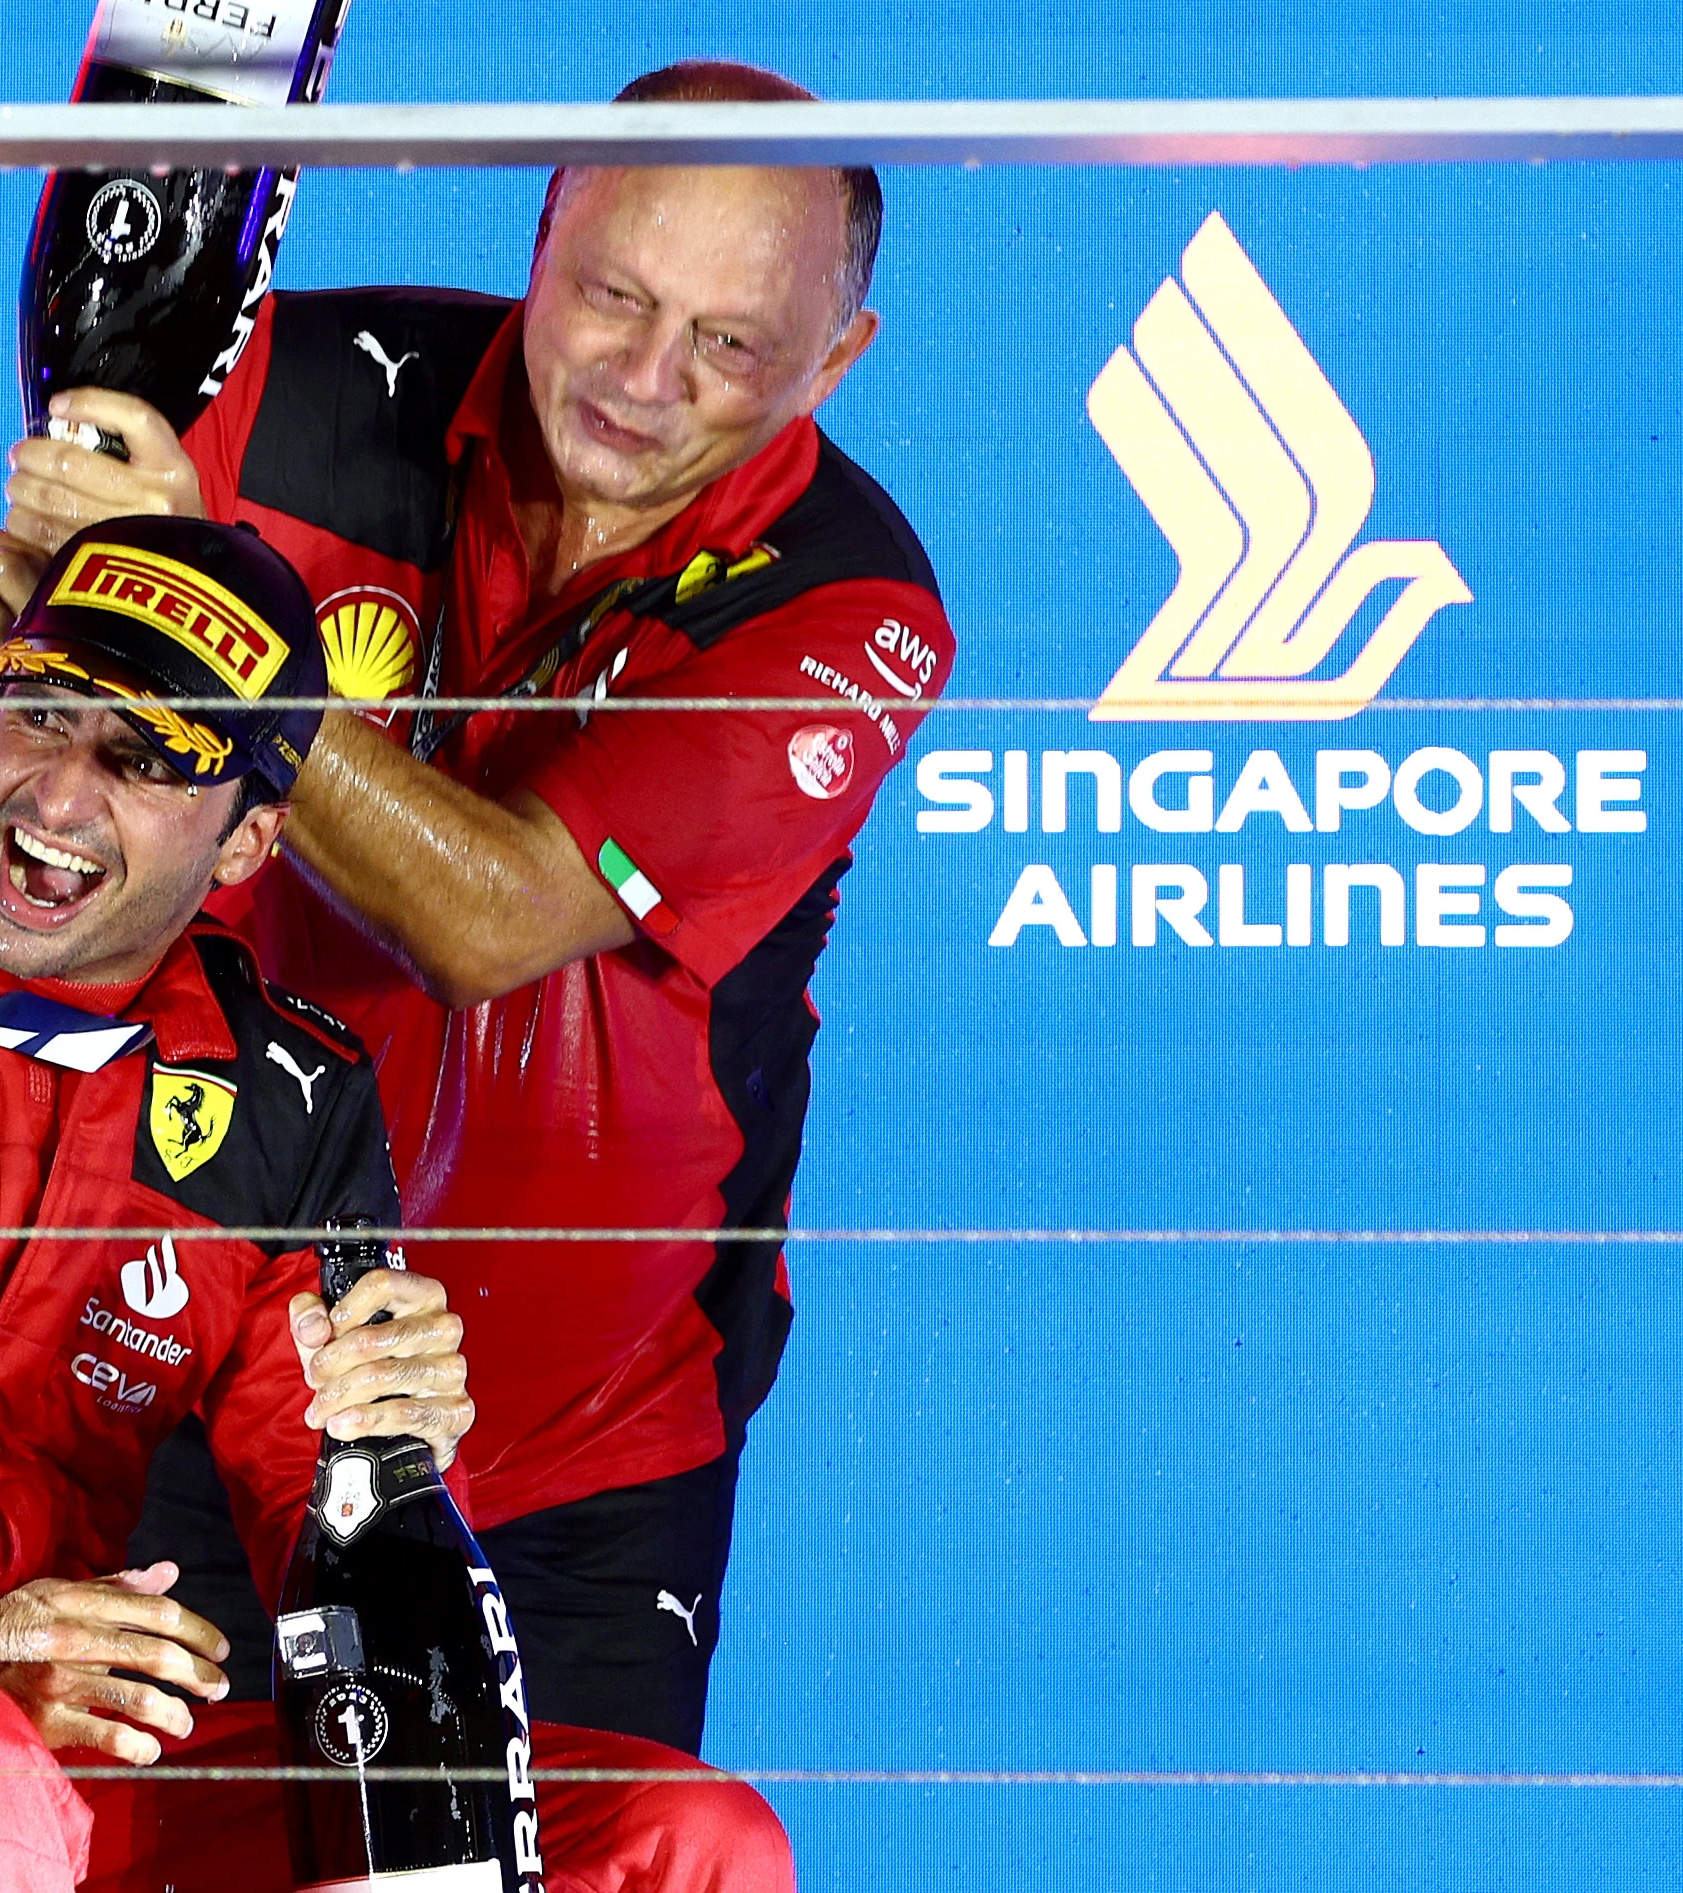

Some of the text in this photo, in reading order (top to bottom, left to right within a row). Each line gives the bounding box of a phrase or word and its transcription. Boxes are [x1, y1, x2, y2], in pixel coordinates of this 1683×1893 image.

[69, 553, 269, 682] PIRELLI
[874, 618, 937, 684] aws
[799, 655, 882, 721] RICHARD
[916, 746, 1648, 836] SINGAPORE
[987, 863, 1574, 948] AIRLINES
[80, 1297, 193, 1367] Santander
[467, 1566, 546, 1893] RRARI
